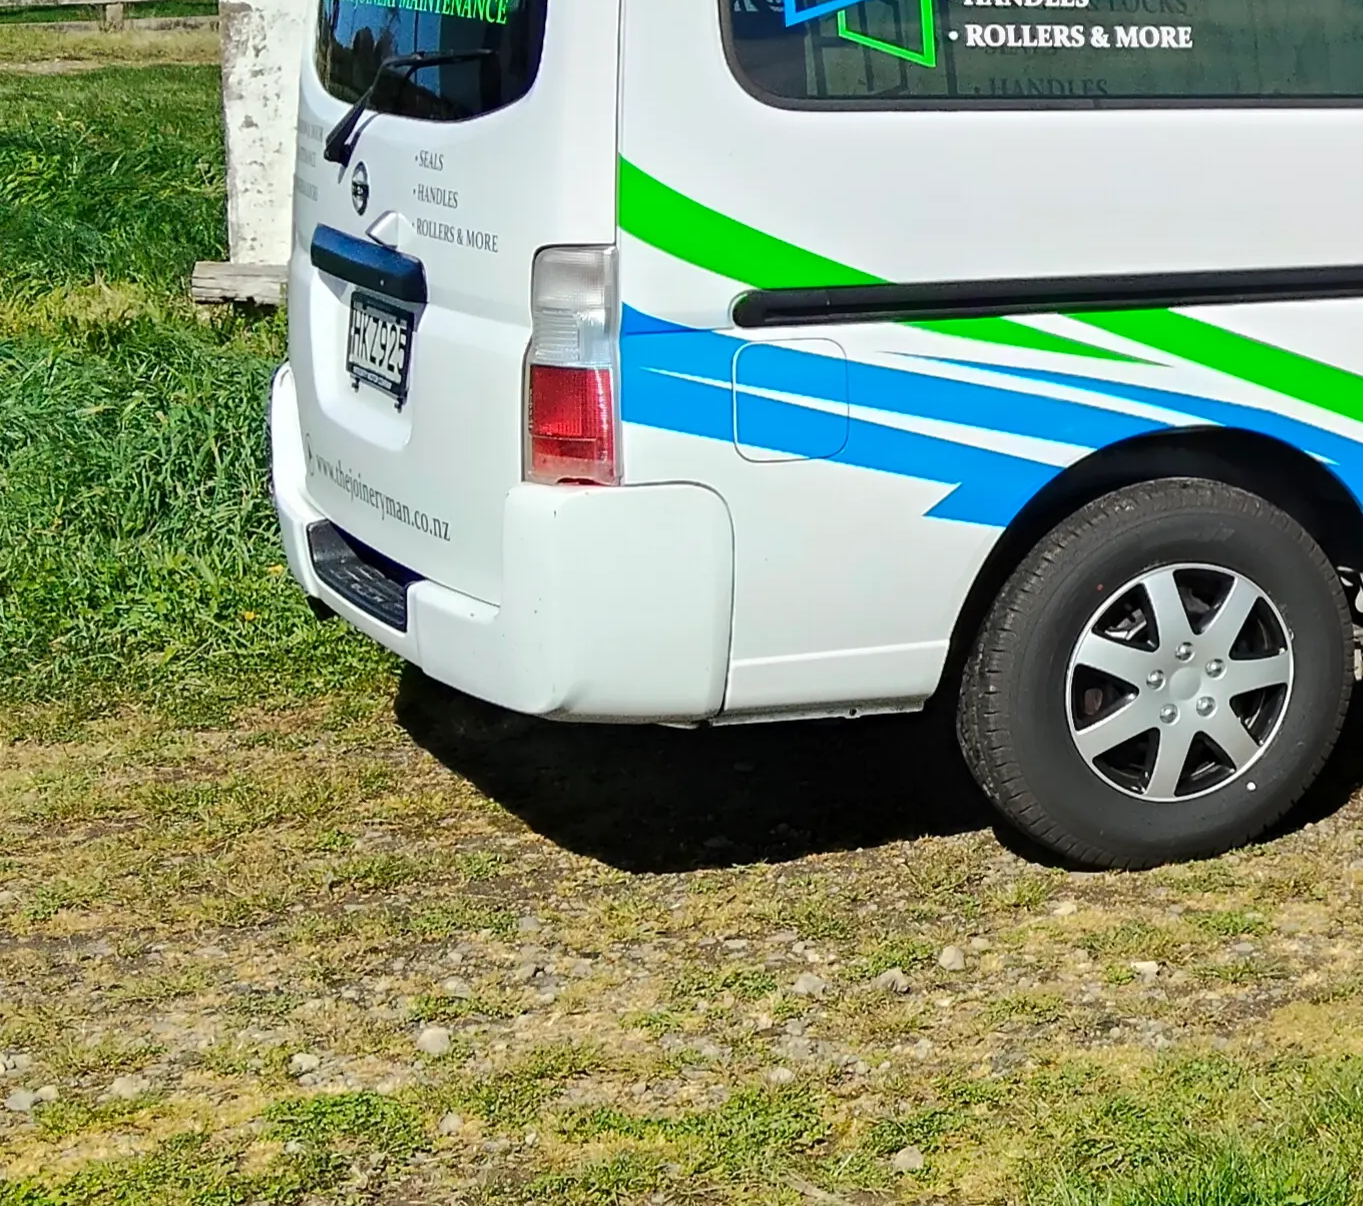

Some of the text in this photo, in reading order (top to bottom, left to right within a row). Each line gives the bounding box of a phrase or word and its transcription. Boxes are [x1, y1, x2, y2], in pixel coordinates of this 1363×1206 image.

[964, 24, 1193, 49] ROLLERS & MORE
[419, 150, 444, 171] SEALS
[417, 183, 458, 209] HANDLES
[417, 218, 499, 253] ROLLERS & MORE
[352, 308, 407, 375] HKZ925
[316, 454, 451, 542] www.thejoineryman.co.nz
